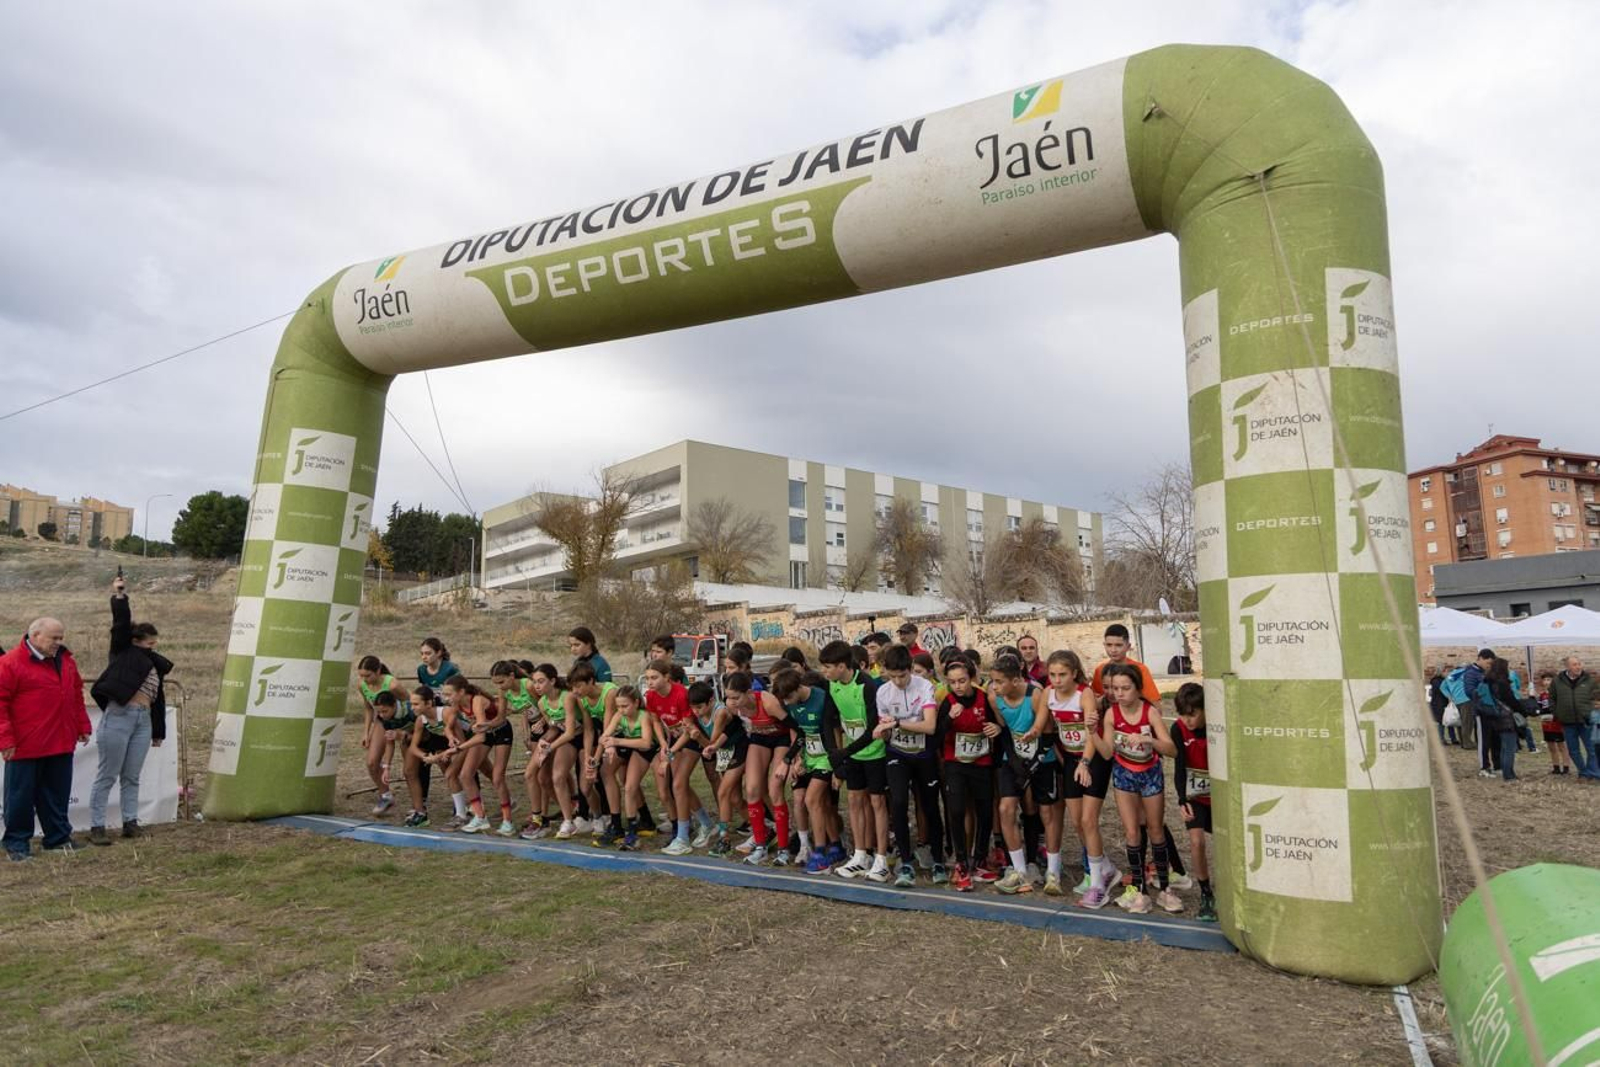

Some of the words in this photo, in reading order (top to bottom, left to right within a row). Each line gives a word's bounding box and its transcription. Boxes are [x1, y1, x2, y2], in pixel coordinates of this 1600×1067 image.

[975, 120, 1094, 190] Jaén
[701, 160, 773, 206] DE
[504, 200, 817, 307] DEPORTES
[353, 283, 410, 325] Jaén
[1230, 313, 1315, 336] DEPORTES
[1250, 412, 1322, 430] DIPUTACIÓN
[1250, 431, 1266, 442] DE
[1266, 427, 1298, 441] JAÉN
[1236, 515, 1322, 532] DEPORTES
[1257, 619, 1330, 632] DIPUTACIÓN
[1257, 635, 1273, 645] DE
[1275, 633, 1305, 645] JAÉN
[1065, 730, 1081, 742] 49
[1243, 726, 1330, 739] DEPORTES
[1265, 833, 1339, 850] DIPUTACIÓN
[1265, 847, 1281, 859] DE
[1283, 848, 1313, 862] JAÉN
